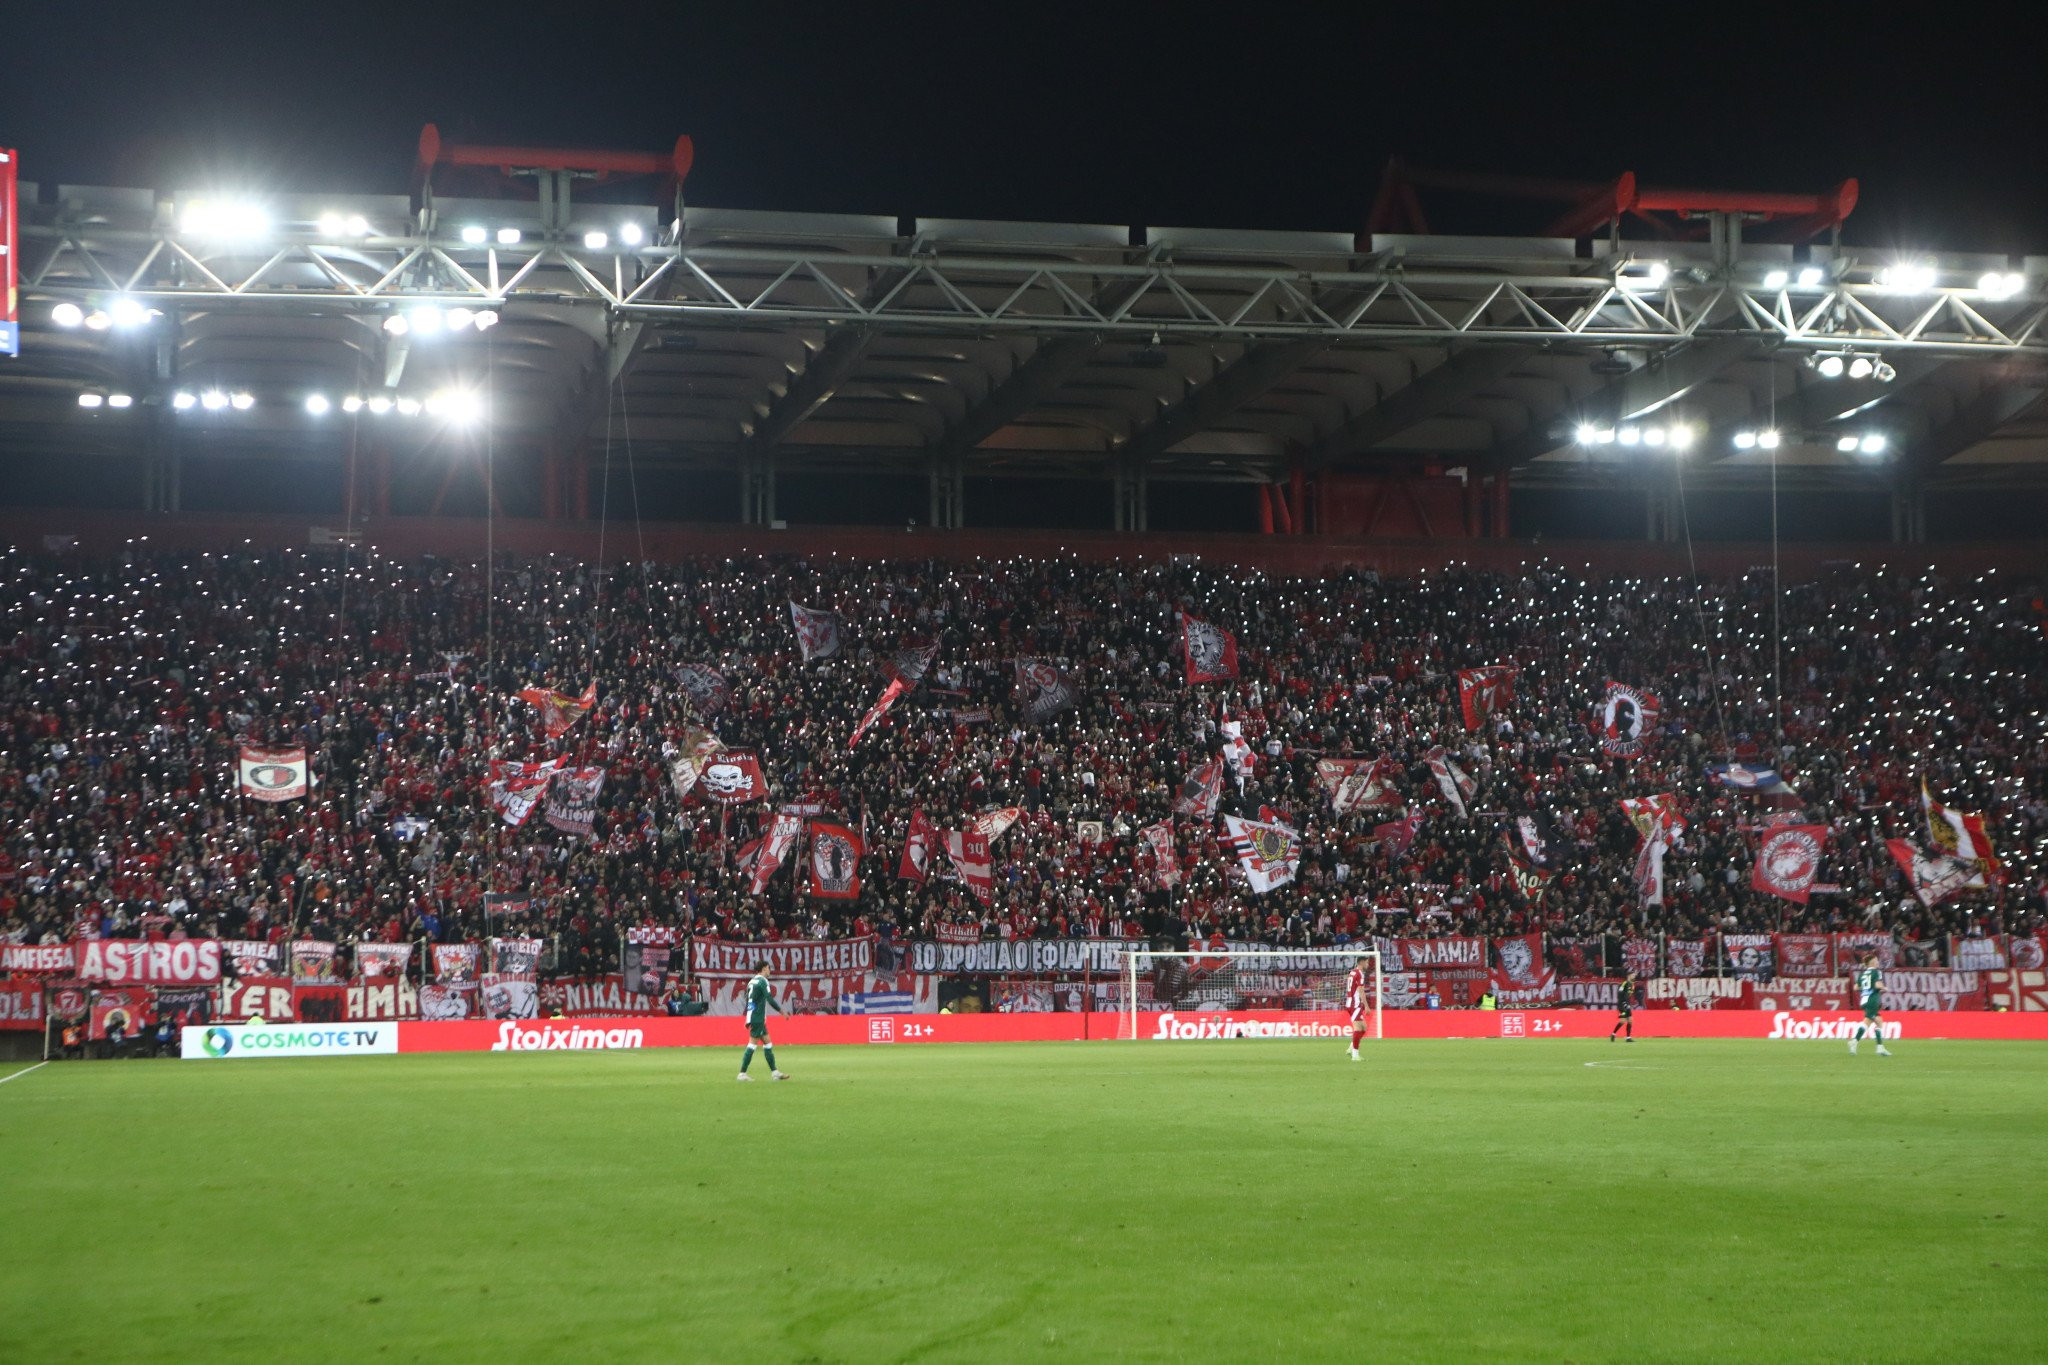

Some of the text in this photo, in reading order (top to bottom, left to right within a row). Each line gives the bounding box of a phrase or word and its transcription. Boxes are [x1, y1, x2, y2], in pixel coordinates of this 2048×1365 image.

[2, 948, 75, 968] AMFISSA
[81, 942, 220, 981] ASTROS
[695, 940, 869, 971] ΧΑΤΖΗΚΥΡΙΑΚΕΙΟ
[914, 942, 937, 970] 10
[941, 941, 1013, 970] ΧΡΟΝΙΑ
[1424, 940, 1480, 963] ΛΑΜΙΑ
[1054, 983, 1095, 993] ΠΕΡΙΣΤΡΙ
[491, 1020, 643, 1050] Stoiximan
[903, 1023, 934, 1036] 21+
[1532, 1019, 1563, 1032] 21+
[240, 1031, 378, 1049] COSMOTE TV
